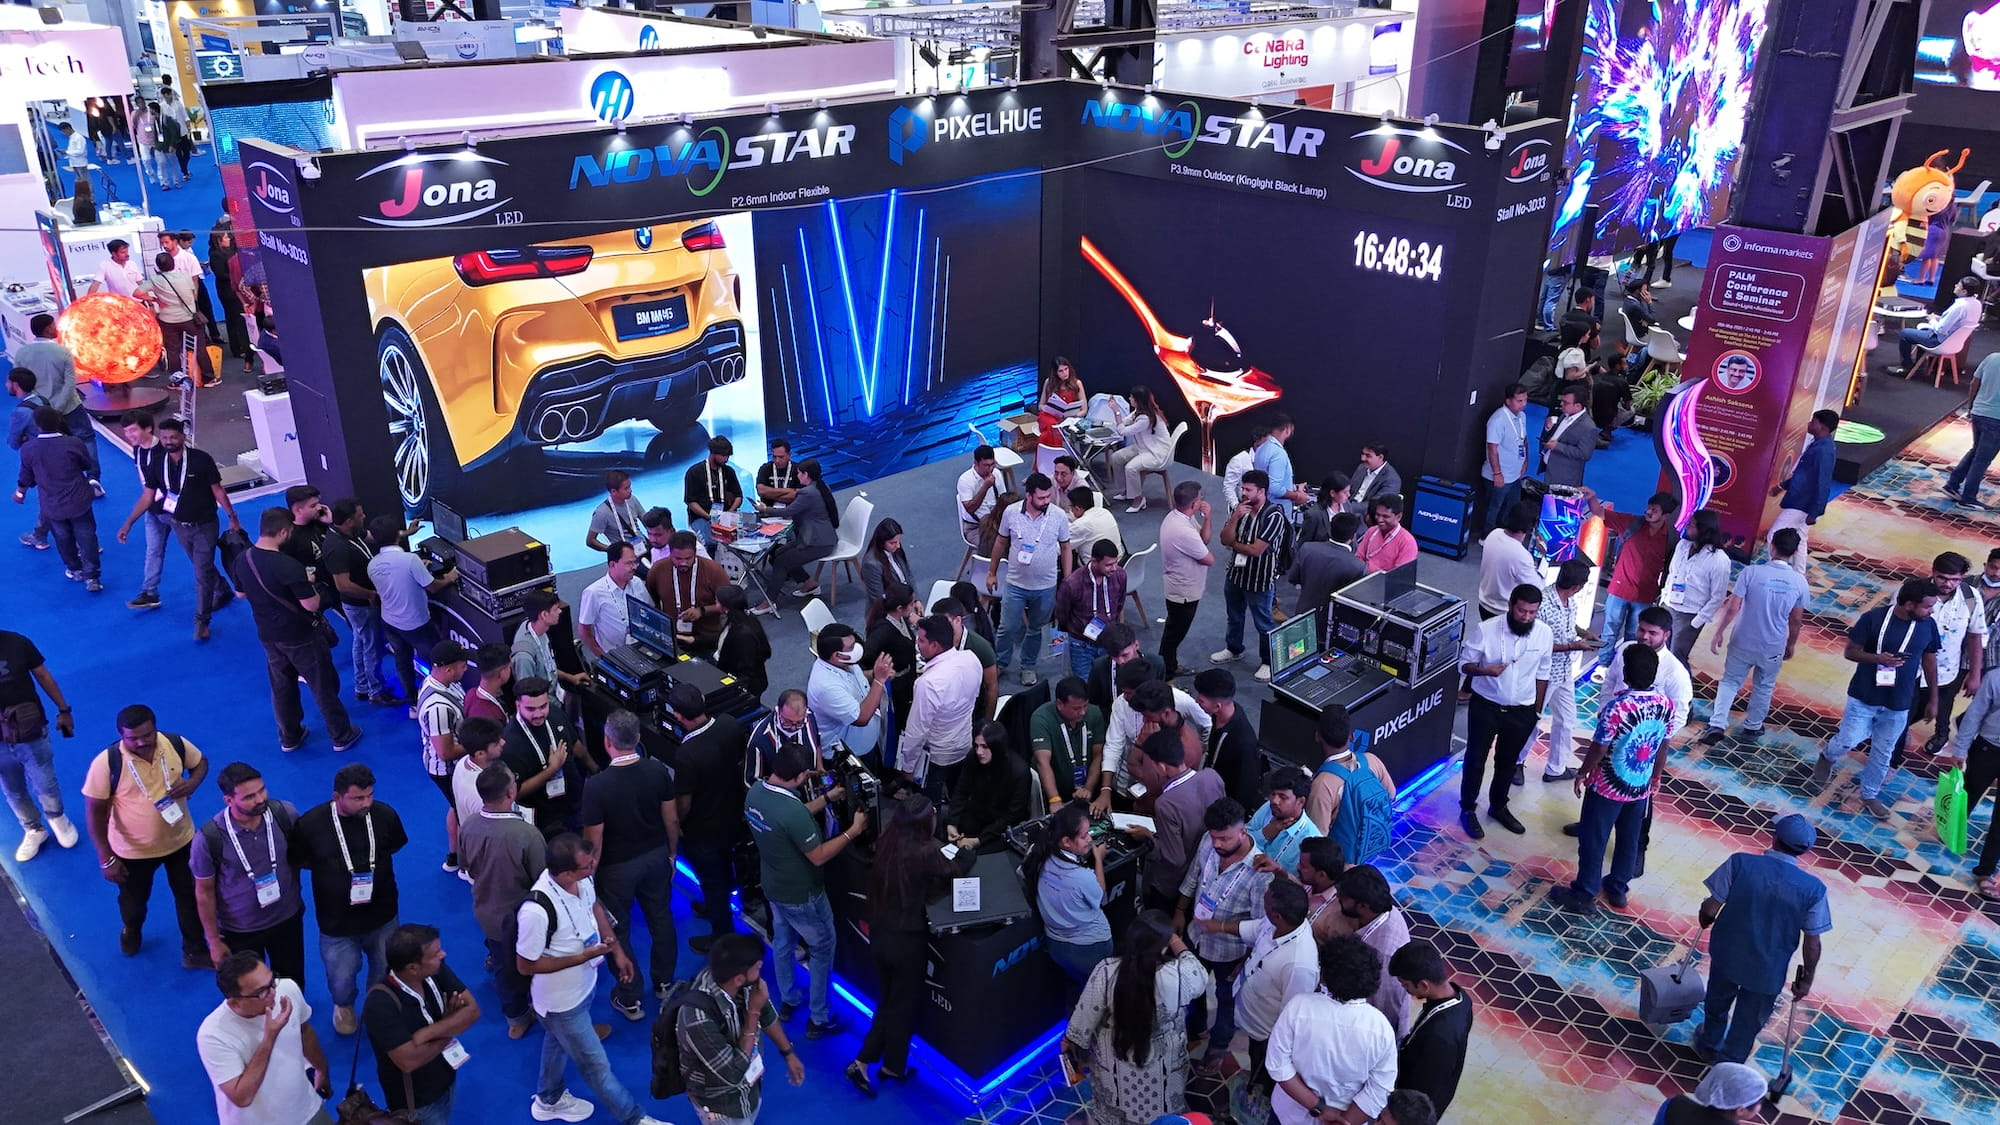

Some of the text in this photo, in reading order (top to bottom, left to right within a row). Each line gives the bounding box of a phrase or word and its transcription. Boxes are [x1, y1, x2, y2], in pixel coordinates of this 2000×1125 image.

[1263, 54, 1309, 69] Lighting
[934, 107, 1043, 143] PIXELHUE
[1360, 138, 1456, 182] Jona
[1510, 149, 1546, 177] Jona
[256, 170, 290, 205] Jona
[379, 168, 497, 218] Jona
[1170, 163, 1202, 178] P3.9mm
[1203, 168, 1235, 184] Outdoor
[1275, 180, 1298, 194] Black
[1299, 185, 1328, 200] Lamp)
[731, 185, 830, 208] P2.6mm Indoor Flexible
[1446, 194, 1472, 210] LED
[495, 210, 524, 226] LED
[1496, 196, 1547, 222] Stall No-3D33
[259, 231, 277, 251] Stall
[1353, 230, 1444, 282] 16:48:34
[1728, 270, 1756, 282] PALM
[1724, 290, 1781, 307] & Seminar
[1726, 280, 1788, 298] Conference
[1373, 688, 1444, 745] PIXELHUE
[930, 990, 952, 1012] LED
